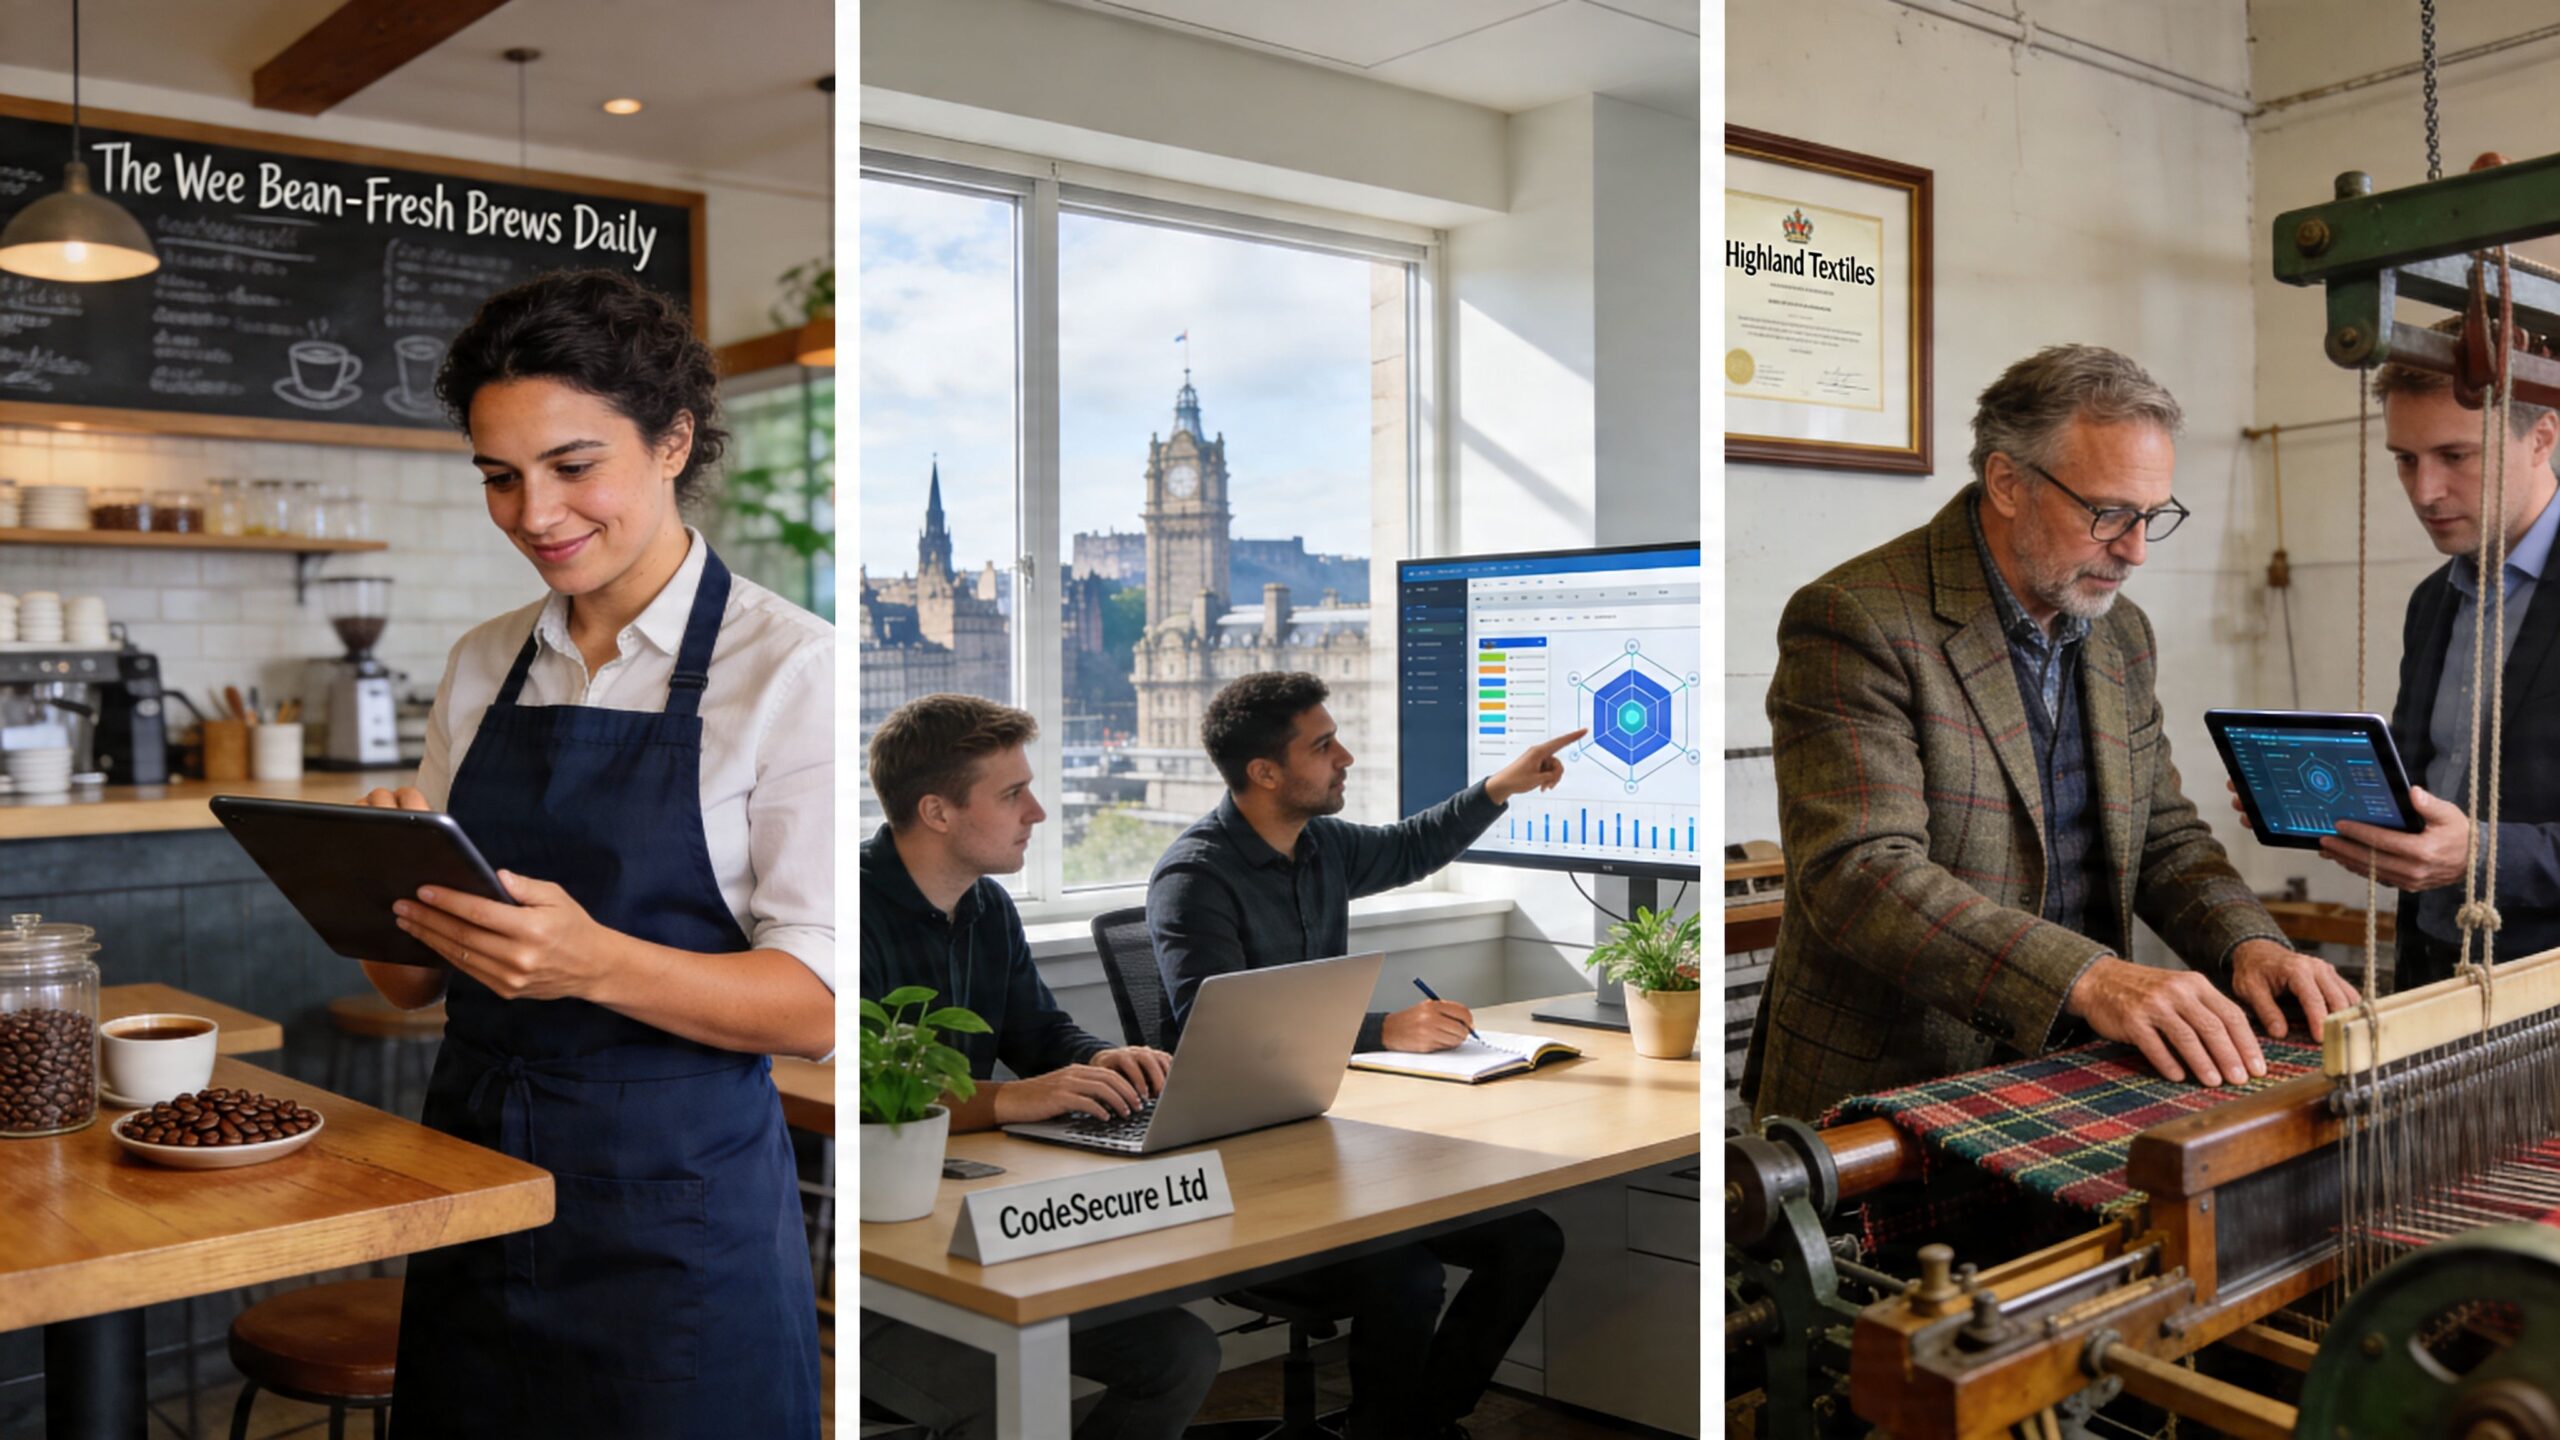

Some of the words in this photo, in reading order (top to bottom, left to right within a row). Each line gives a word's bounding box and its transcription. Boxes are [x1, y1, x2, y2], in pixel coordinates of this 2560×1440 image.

[92, 142, 162, 195] The
[174, 152, 246, 203] Wee
[259, 163, 455, 231] Bean-Fresh
[466, 191, 563, 245] Brews
[573, 204, 658, 271] Daily
[1726, 240, 1804, 276] Highland
[1808, 251, 1875, 286] Textiles
[1000, 1186, 1159, 1239] CodeSecure
[1165, 1168, 1208, 1207] Ltd
